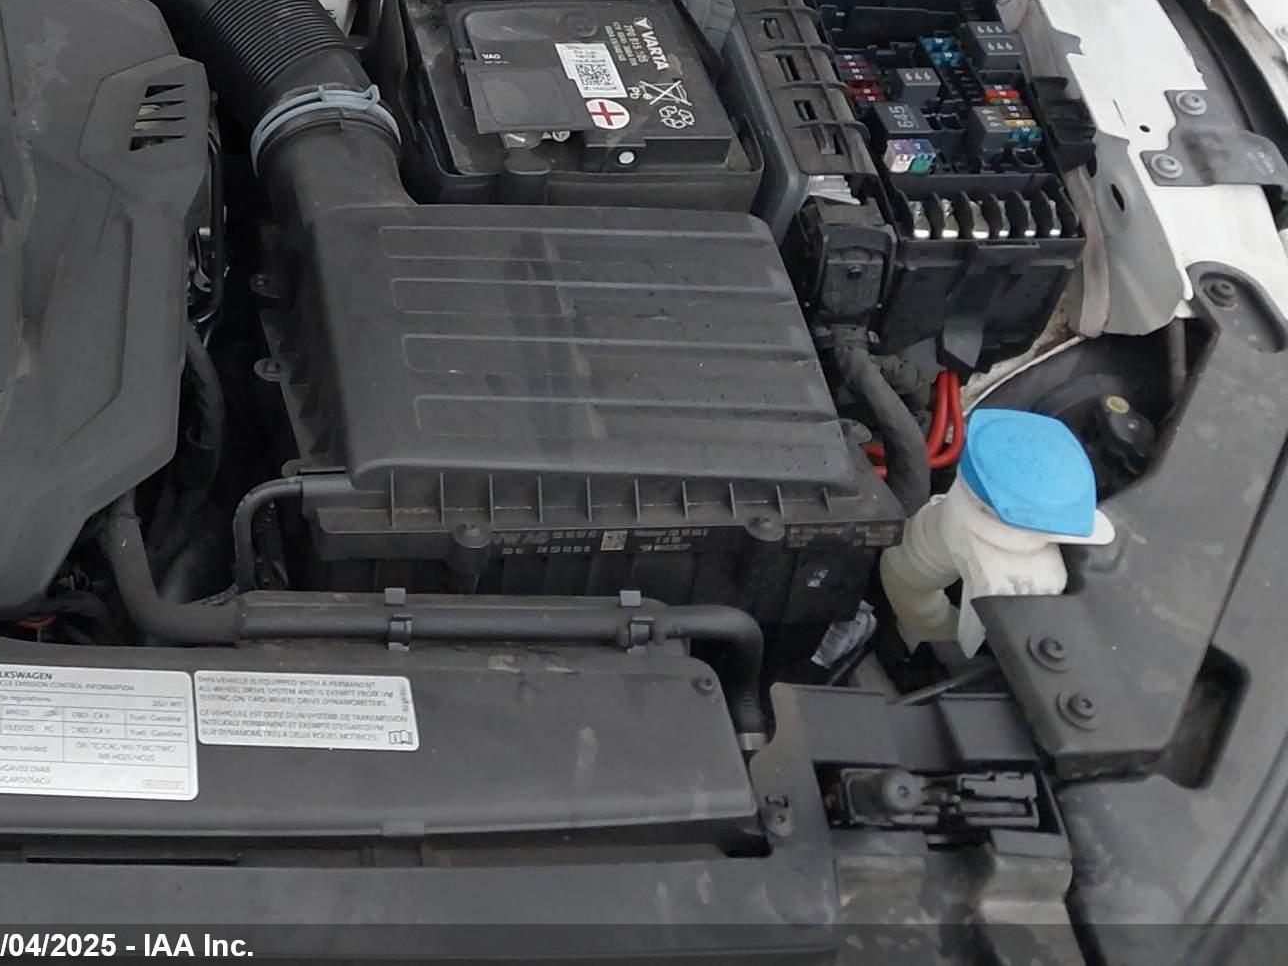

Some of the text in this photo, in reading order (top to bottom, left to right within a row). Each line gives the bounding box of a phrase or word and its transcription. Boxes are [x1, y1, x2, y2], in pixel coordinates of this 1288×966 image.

[642, 31, 669, 70] VARTA
[988, 42, 1013, 51] 646
[905, 72, 931, 81] 646
[626, 86, 642, 100] Pb
[888, 105, 914, 128] 645
